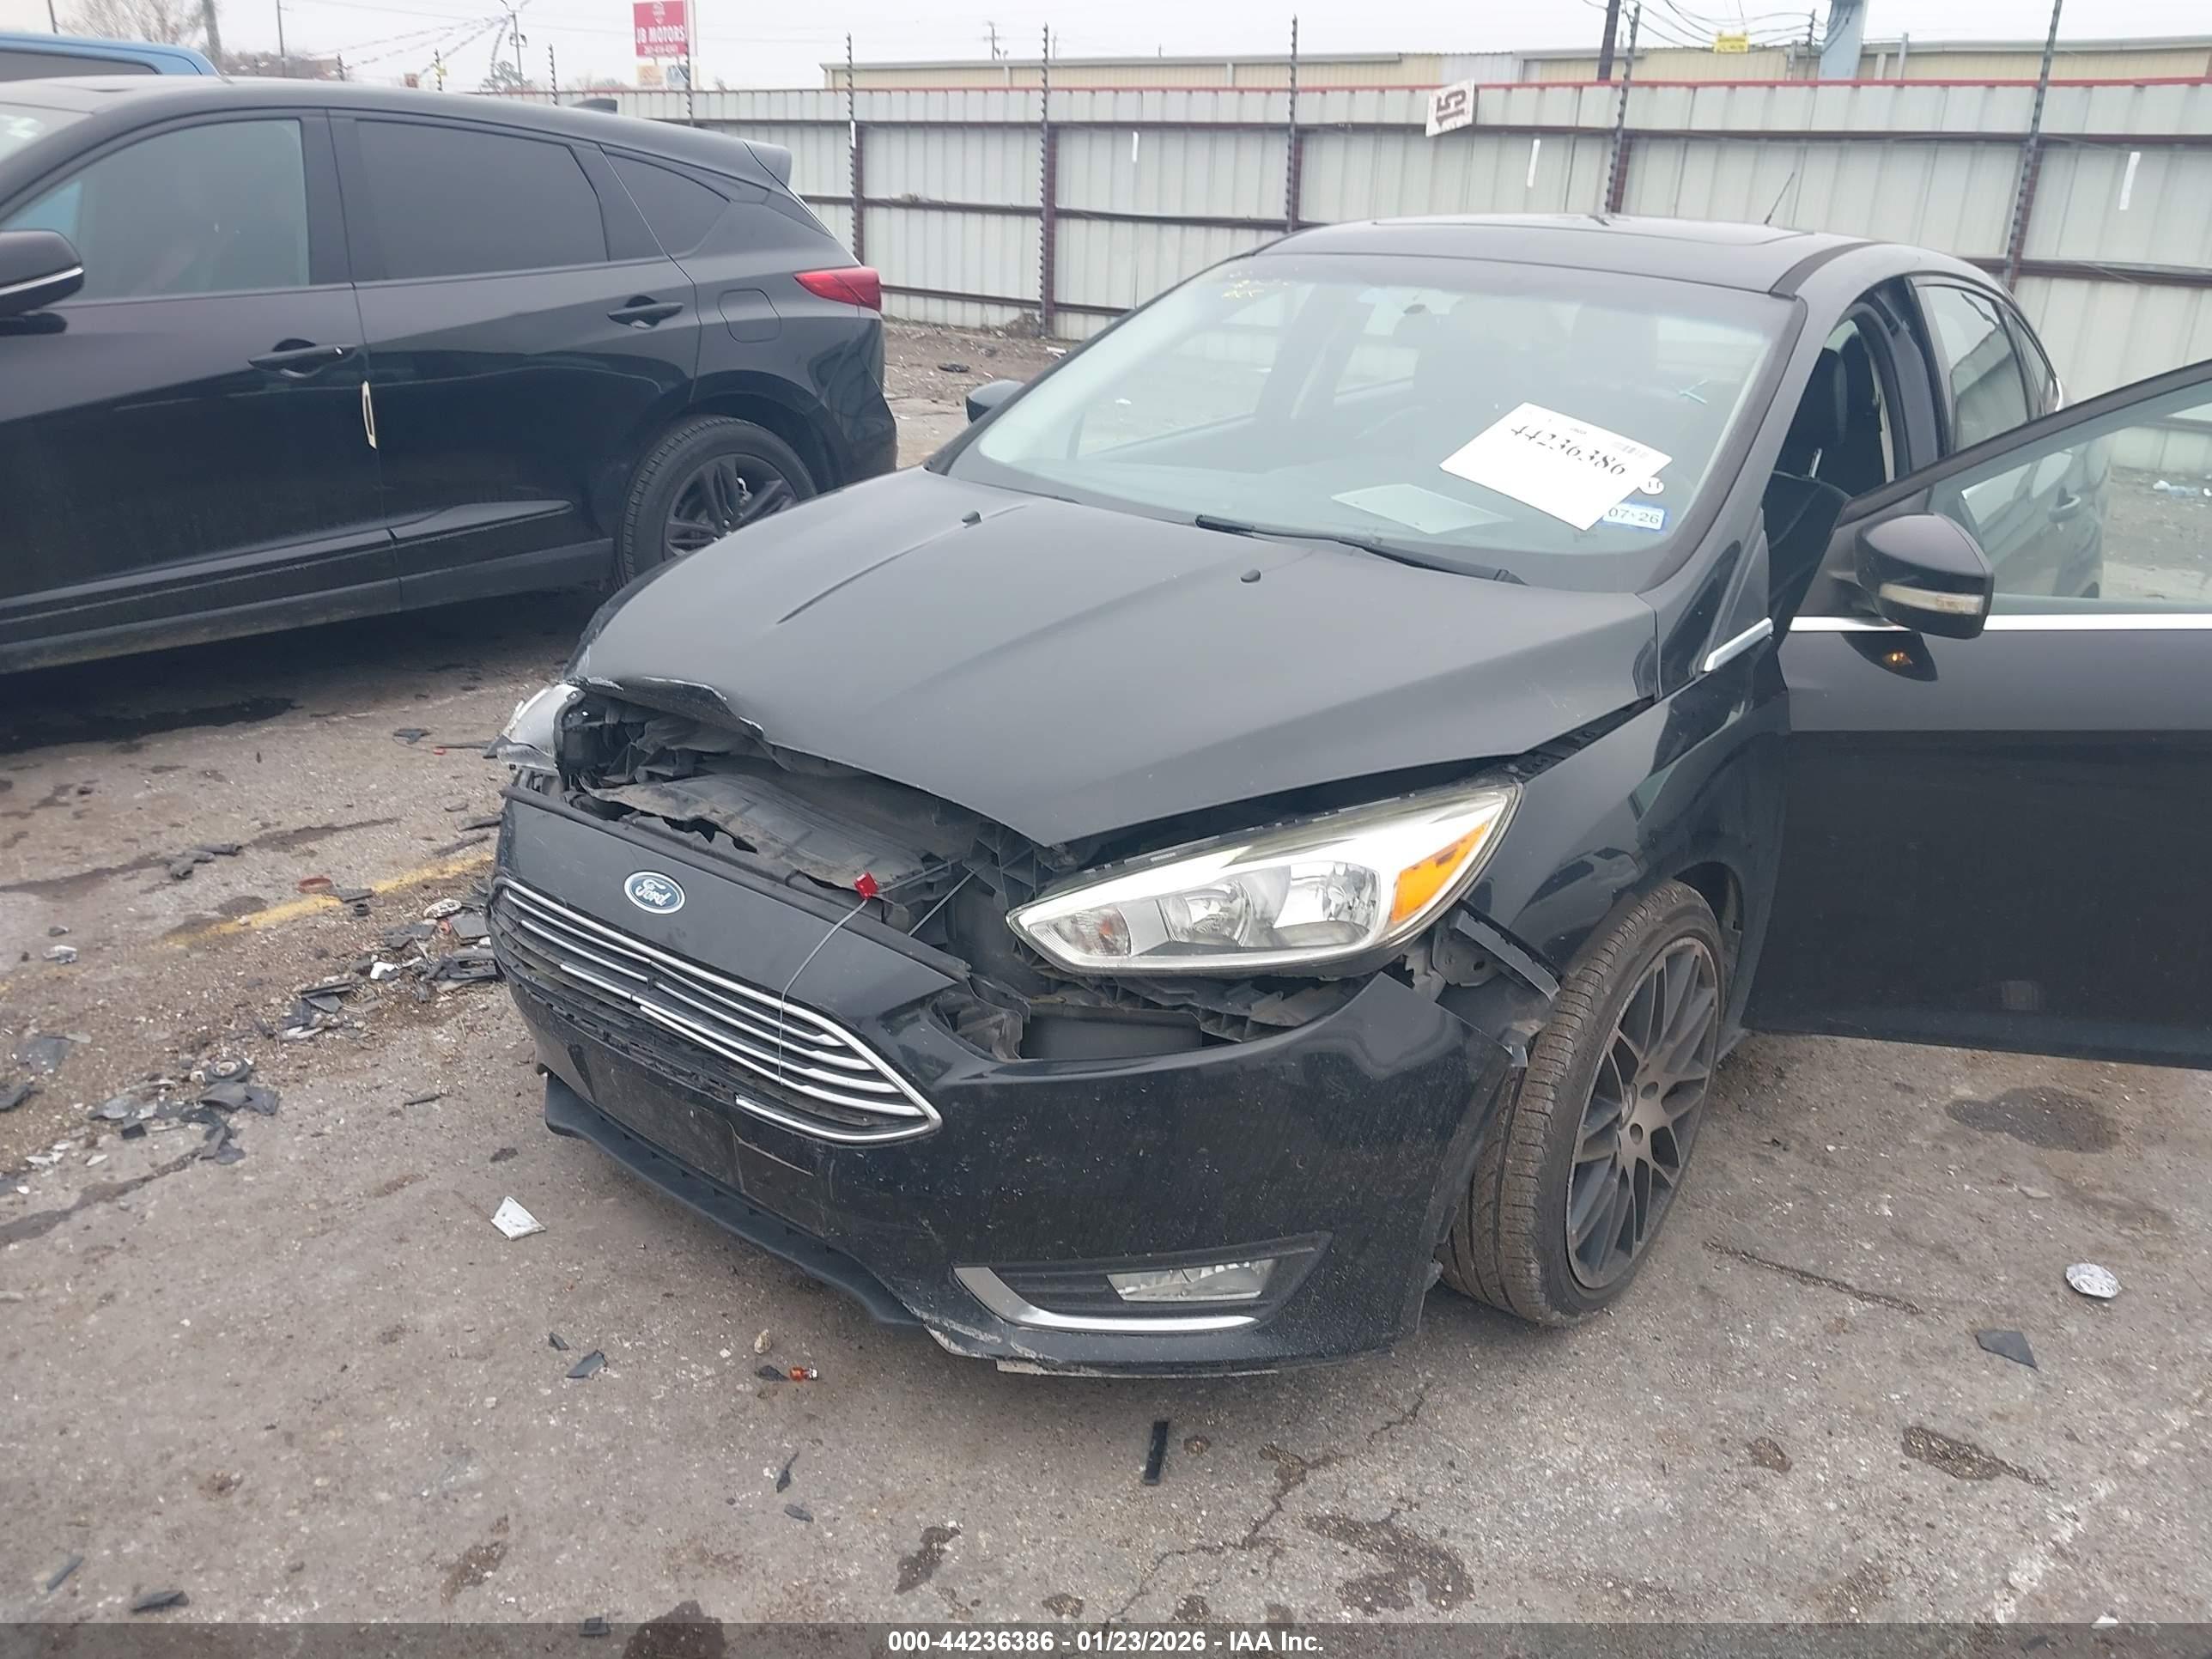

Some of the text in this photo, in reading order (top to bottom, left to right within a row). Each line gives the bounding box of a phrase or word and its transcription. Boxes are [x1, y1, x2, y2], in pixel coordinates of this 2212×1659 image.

[1436, 89, 1467, 126] 15
[1510, 425, 1626, 476] 44236386
[635, 878, 672, 907] Ford
